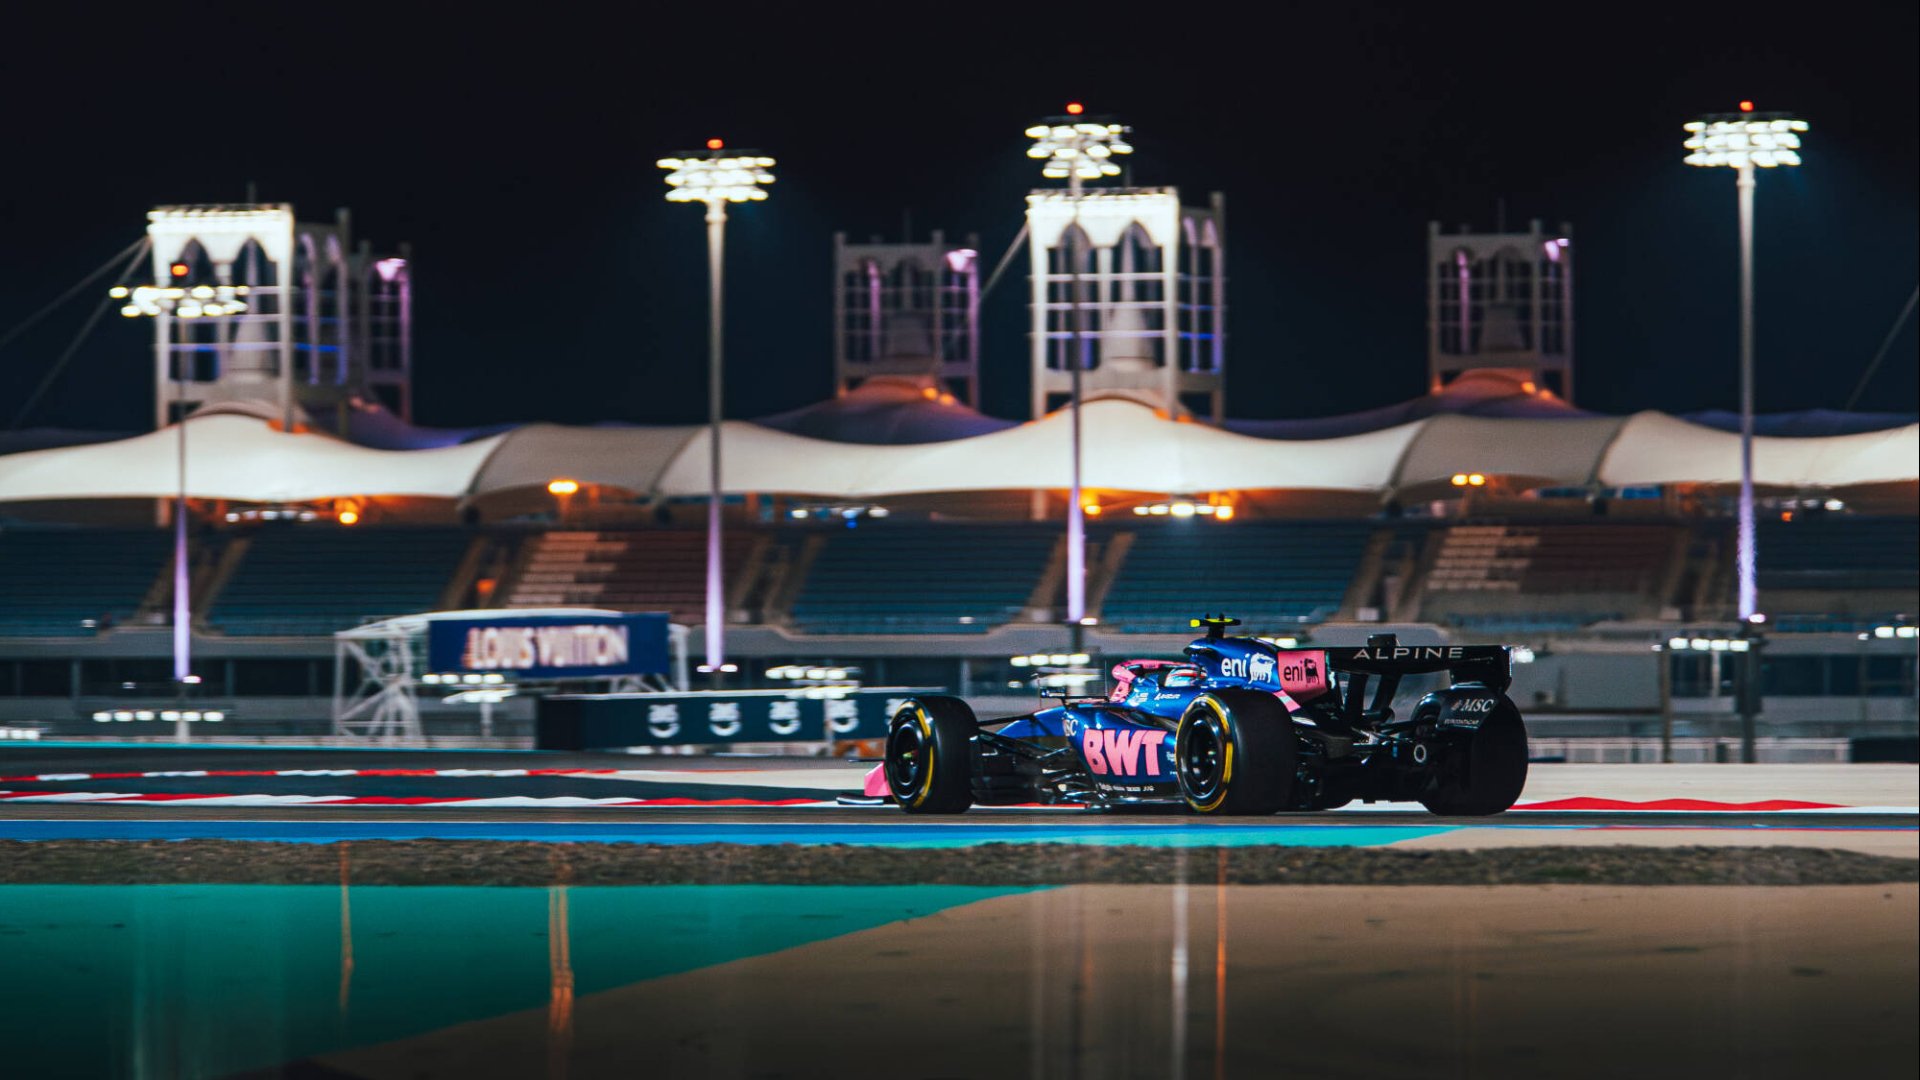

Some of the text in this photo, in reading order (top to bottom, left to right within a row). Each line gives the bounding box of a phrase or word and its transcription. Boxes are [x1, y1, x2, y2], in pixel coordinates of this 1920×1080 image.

[1353, 647, 1463, 659] ALPINE
[1221, 653, 1250, 677] eni
[1283, 660, 1303, 681] eni
[1460, 698, 1494, 713] MSC
[1083, 728, 1168, 776] BWT
